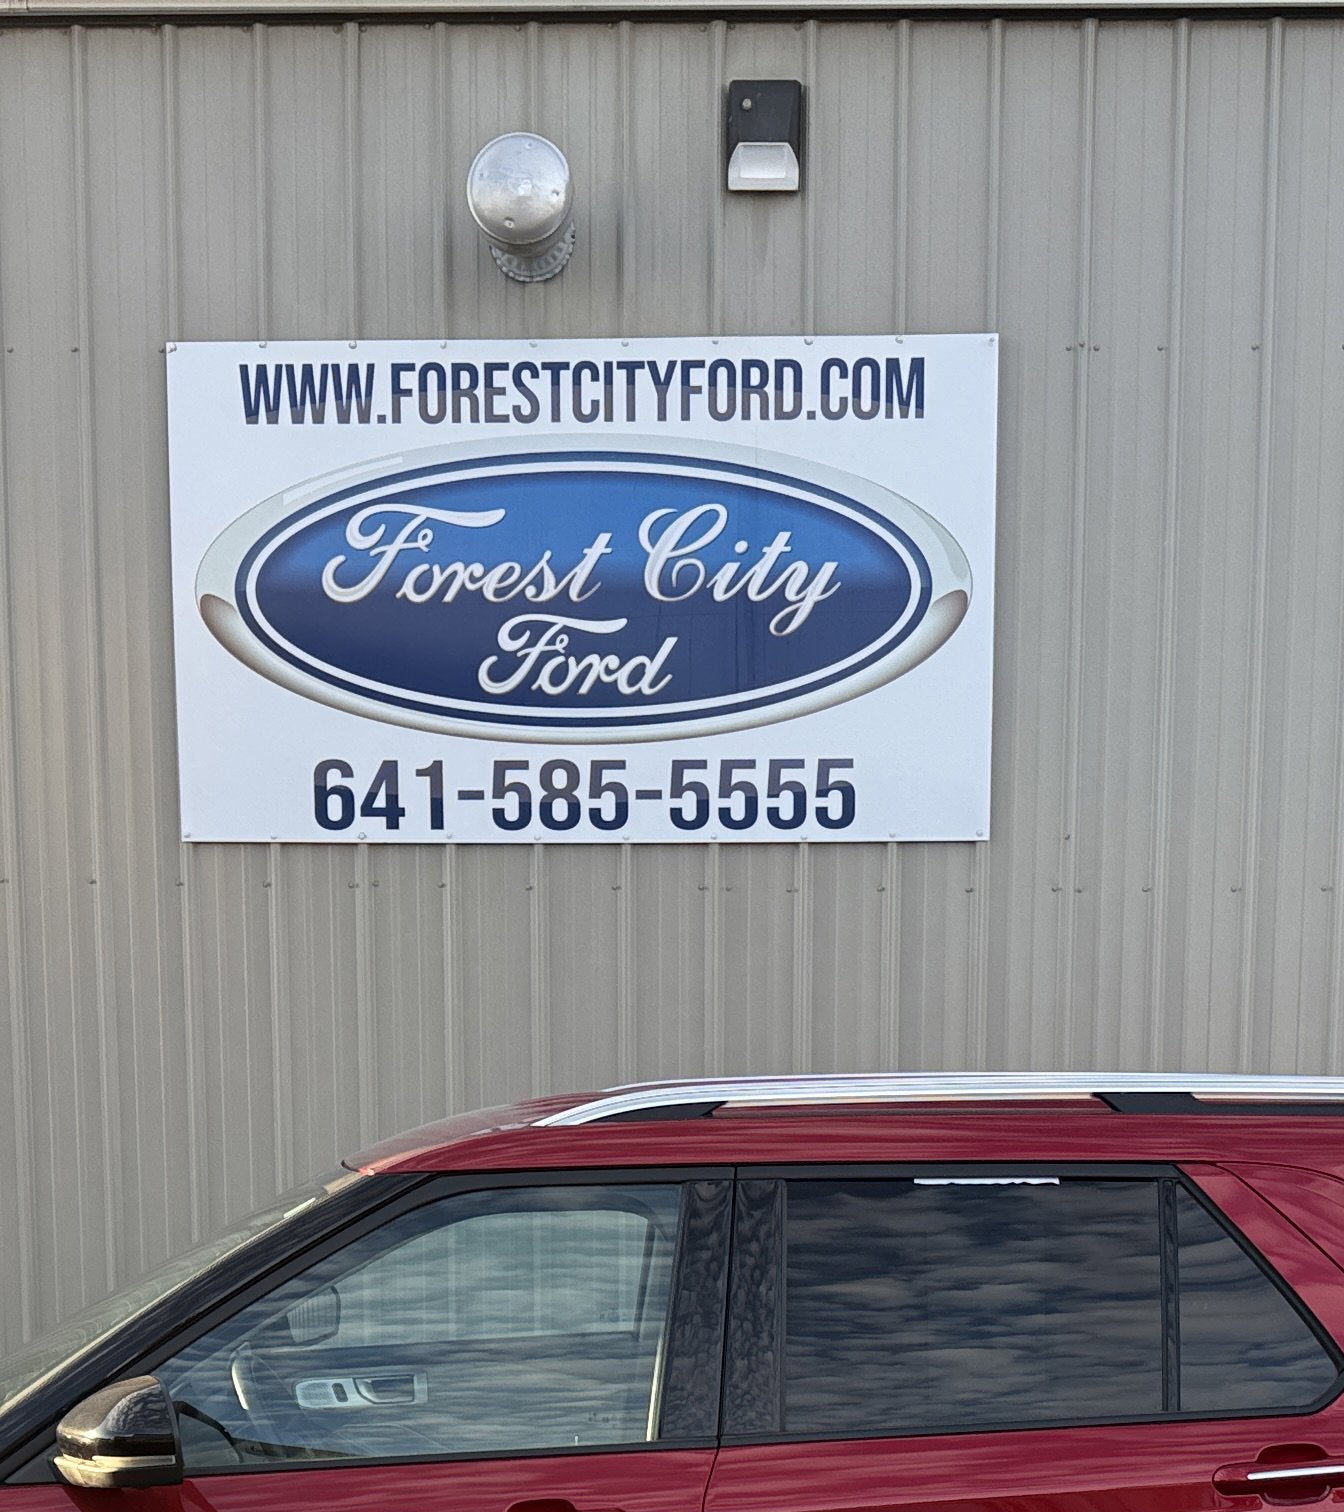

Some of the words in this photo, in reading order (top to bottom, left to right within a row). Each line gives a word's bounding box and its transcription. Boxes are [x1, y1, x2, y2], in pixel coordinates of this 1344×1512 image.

[240, 357, 926, 425] WWW.FORESTCITYFORD.COM
[321, 503, 612, 604] Forest
[638, 503, 841, 636] City
[477, 613, 678, 695] Ford
[312, 758, 857, 831] 641-585-5555
